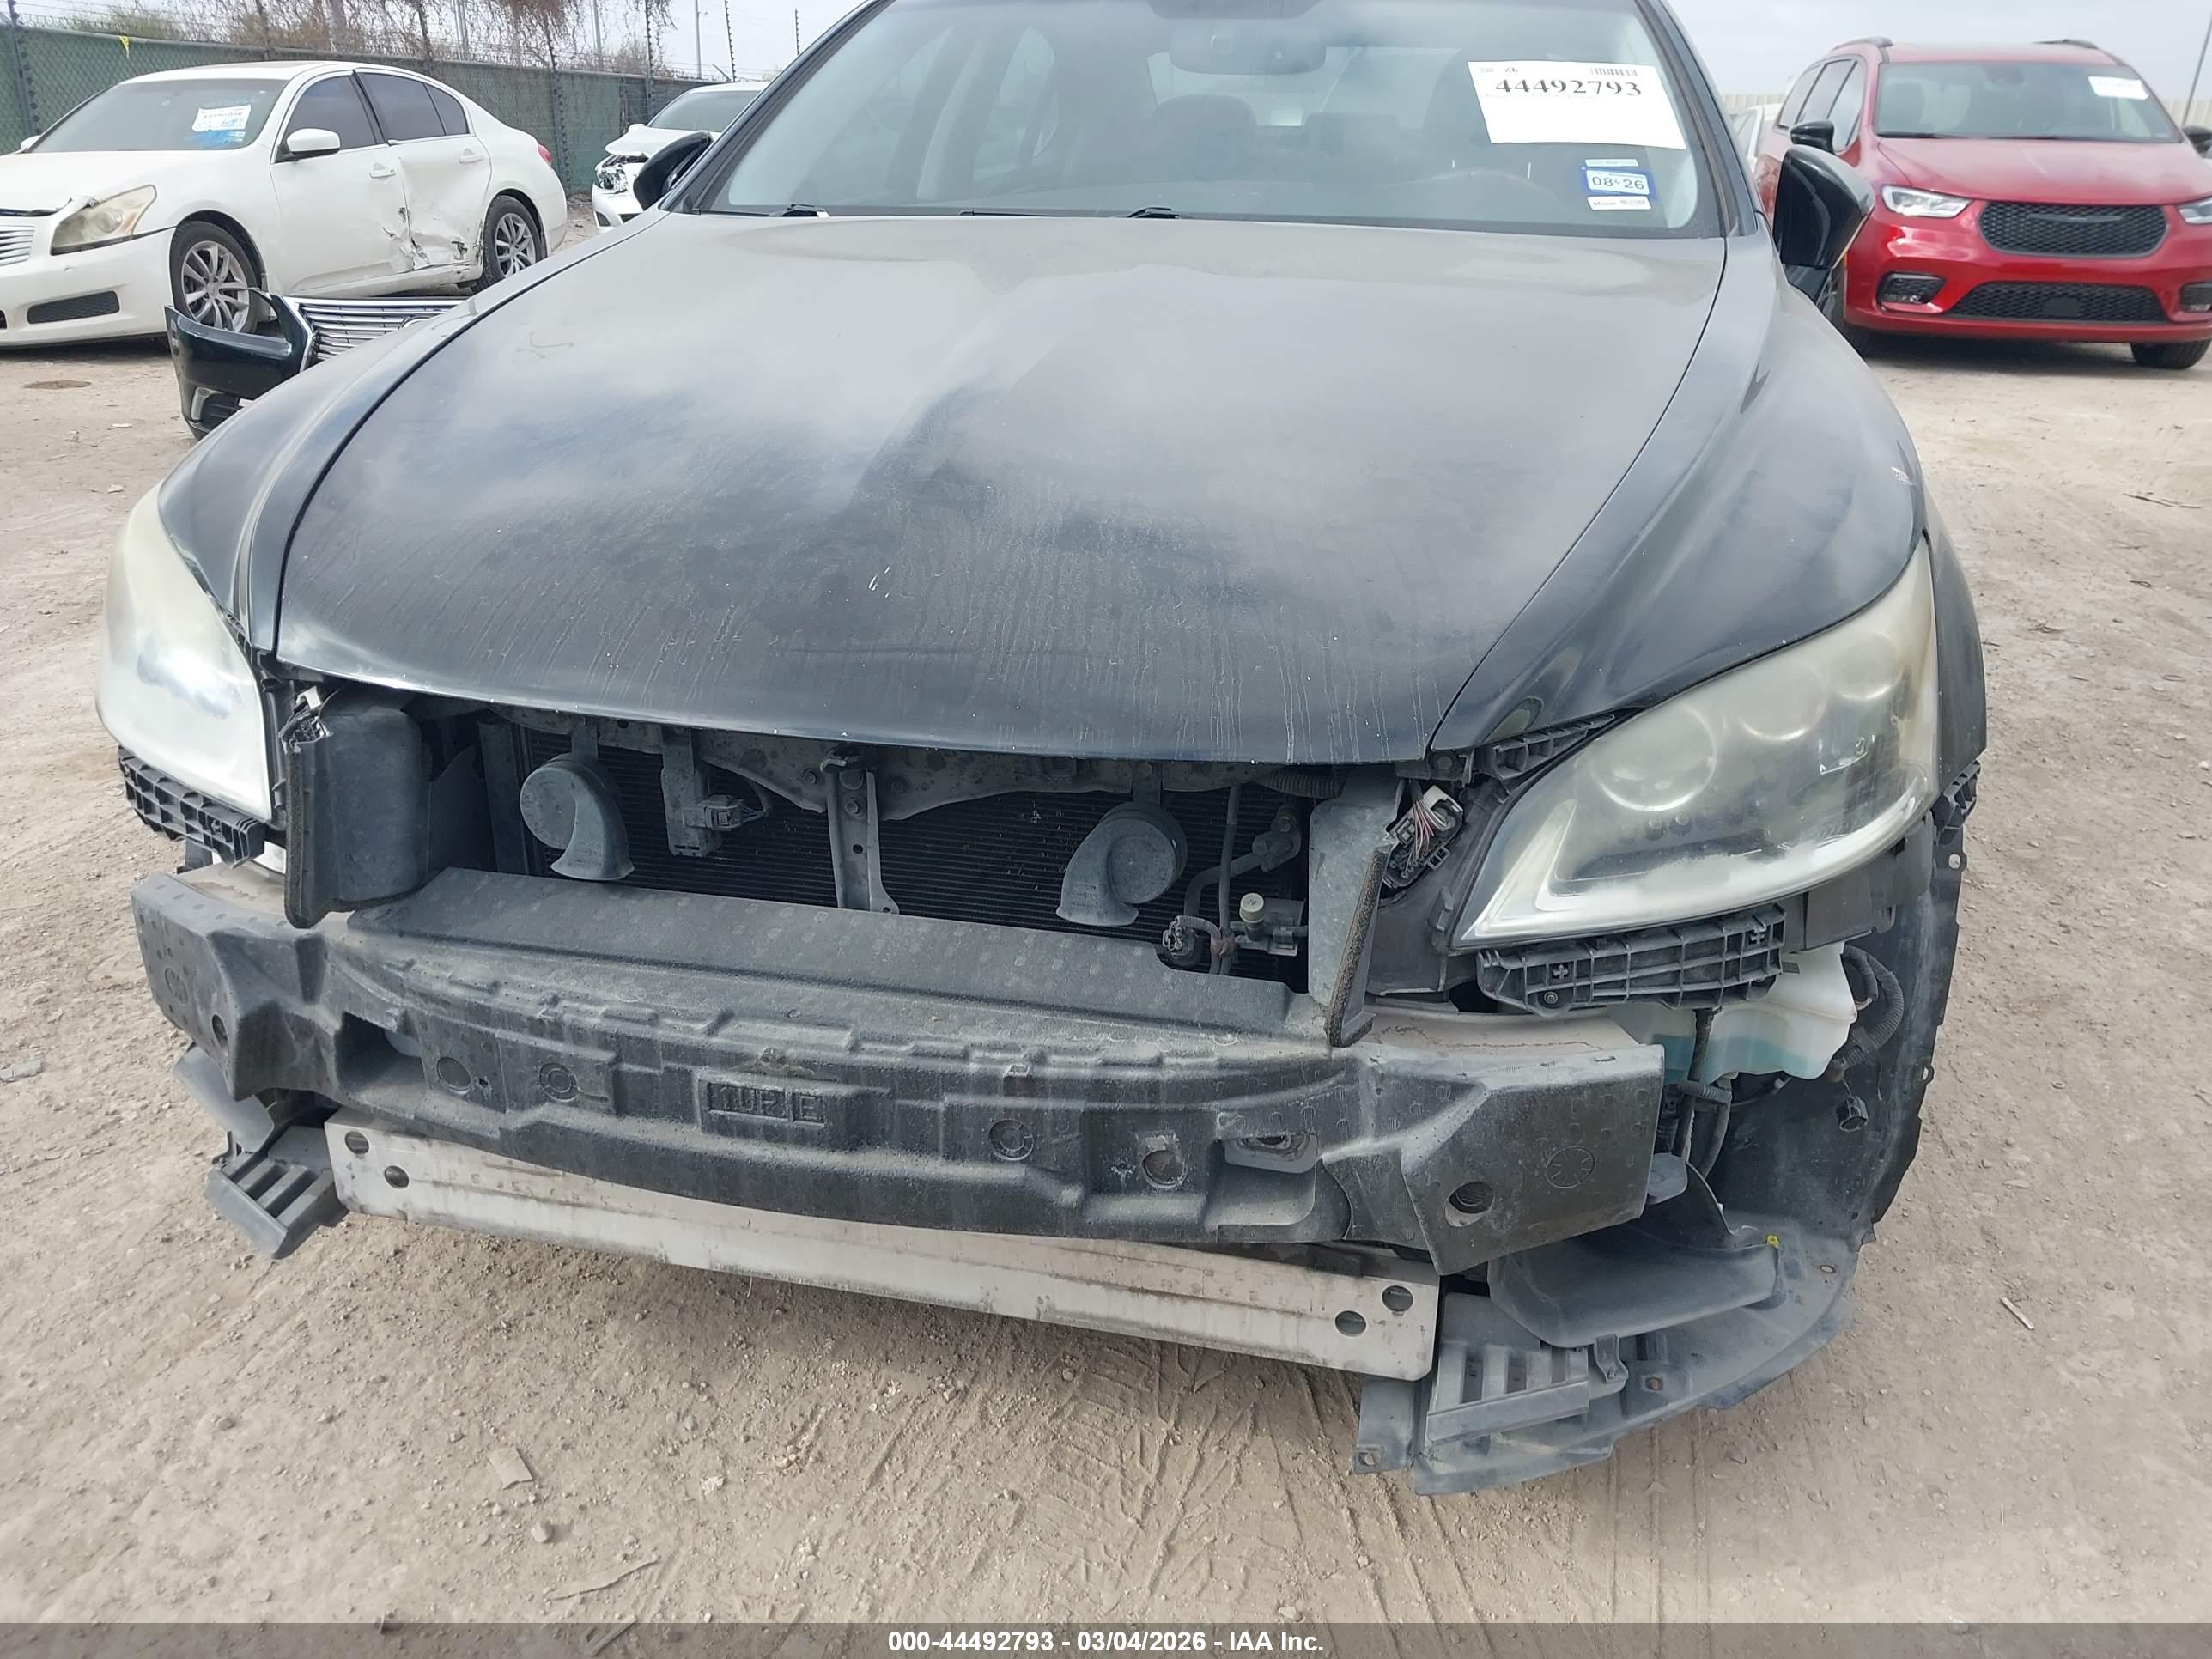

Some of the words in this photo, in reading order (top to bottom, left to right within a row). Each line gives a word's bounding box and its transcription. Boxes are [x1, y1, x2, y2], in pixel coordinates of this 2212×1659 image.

[1495, 79, 1642, 96] 44492793
[1592, 176, 1613, 187] 08
[1622, 179, 1644, 190] 26
